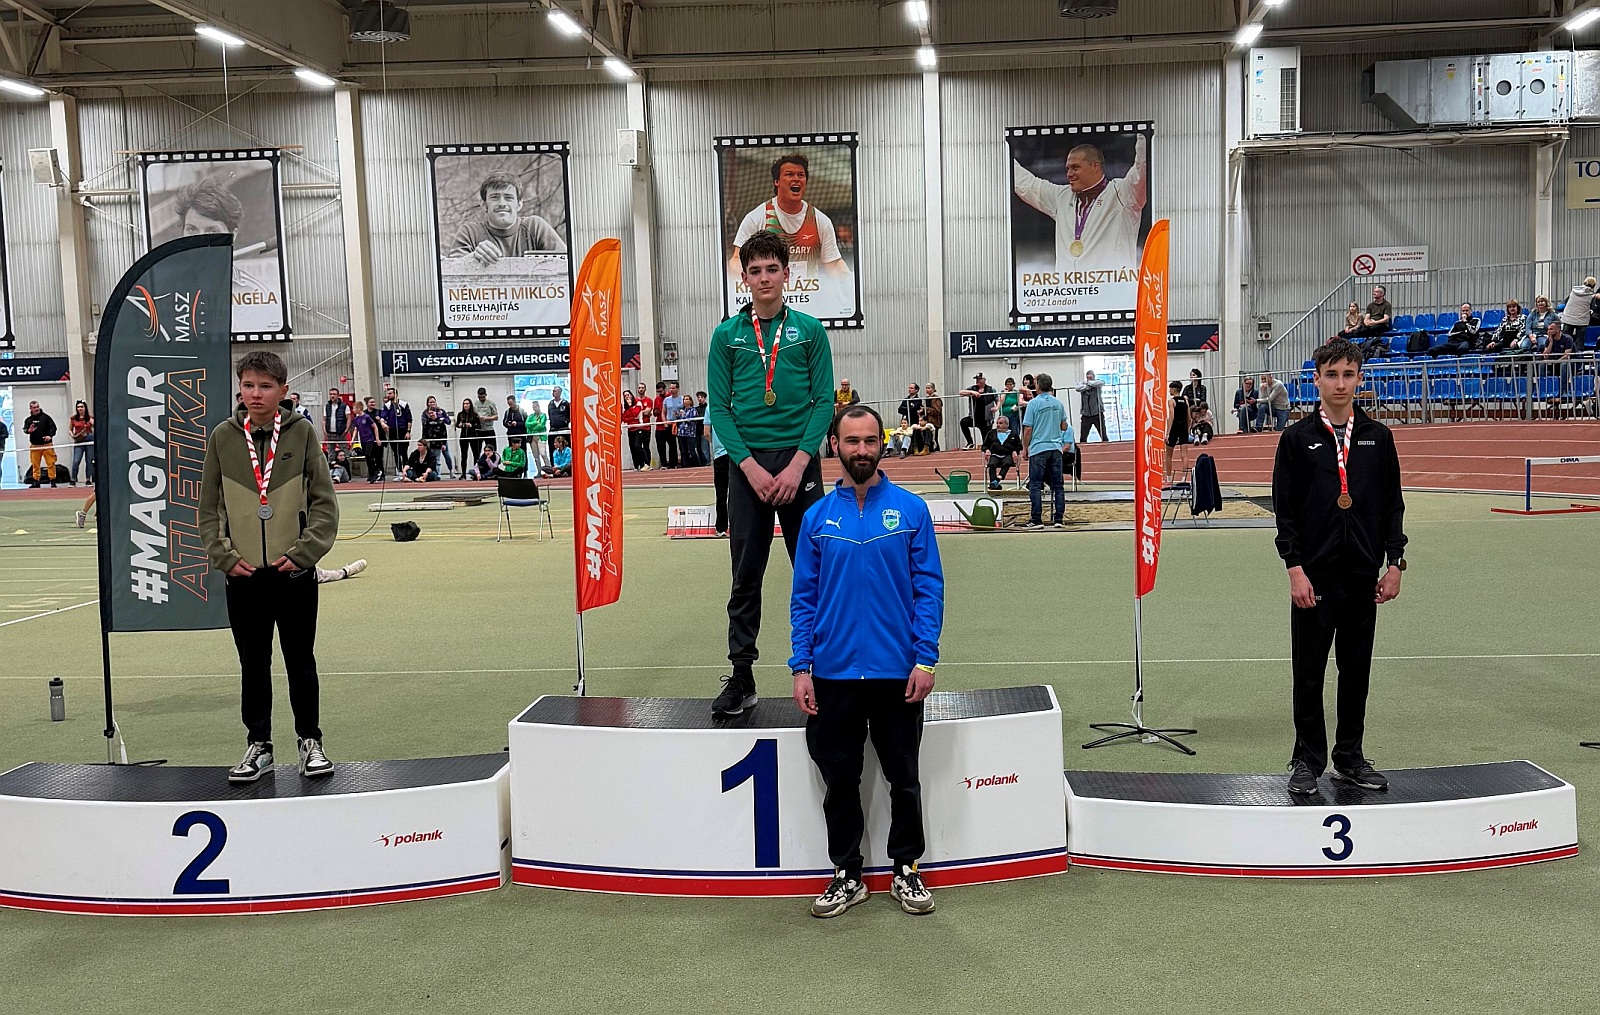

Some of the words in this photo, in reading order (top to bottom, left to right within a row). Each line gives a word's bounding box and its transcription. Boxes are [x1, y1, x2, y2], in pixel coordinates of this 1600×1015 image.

[789, 246, 812, 254] GARY
[1023, 272, 1060, 286] PARS
[1064, 266, 1139, 285] KRISZTIÁN
[232, 288, 278, 306] NGÉLA
[448, 284, 508, 301] NÉMETH
[511, 282, 566, 300] MIKLÓS
[1023, 285, 1099, 298] KALAPÁCSVETÉS
[1152, 272, 1162, 319] MASZ
[449, 301, 520, 313] GERELYHAJÍTÁS
[1047, 297, 1077, 306] London
[174, 291, 190, 342] MASZ
[472, 312, 509, 321] Montreal
[598, 289, 608, 336] MASZ
[986, 335, 1067, 349] VÉSZKIJÁRAT
[1078, 334, 1136, 347] EMERGEN
[417, 353, 497, 367] VÉSZKIJÁRAT
[506, 353, 570, 365] EMERGENC
[16, 365, 42, 375] EXIT
[583, 358, 602, 580] #MAGYAR
[128, 365, 168, 604] #MAGYAR
[168, 367, 208, 601] ATLETIKA
[976, 773, 1019, 790] polanik
[721, 739, 780, 868] 1
[1500, 819, 1539, 836] polanik
[394, 829, 443, 847] polanik
[1321, 813, 1354, 862] 3
[172, 810, 230, 894] 2
